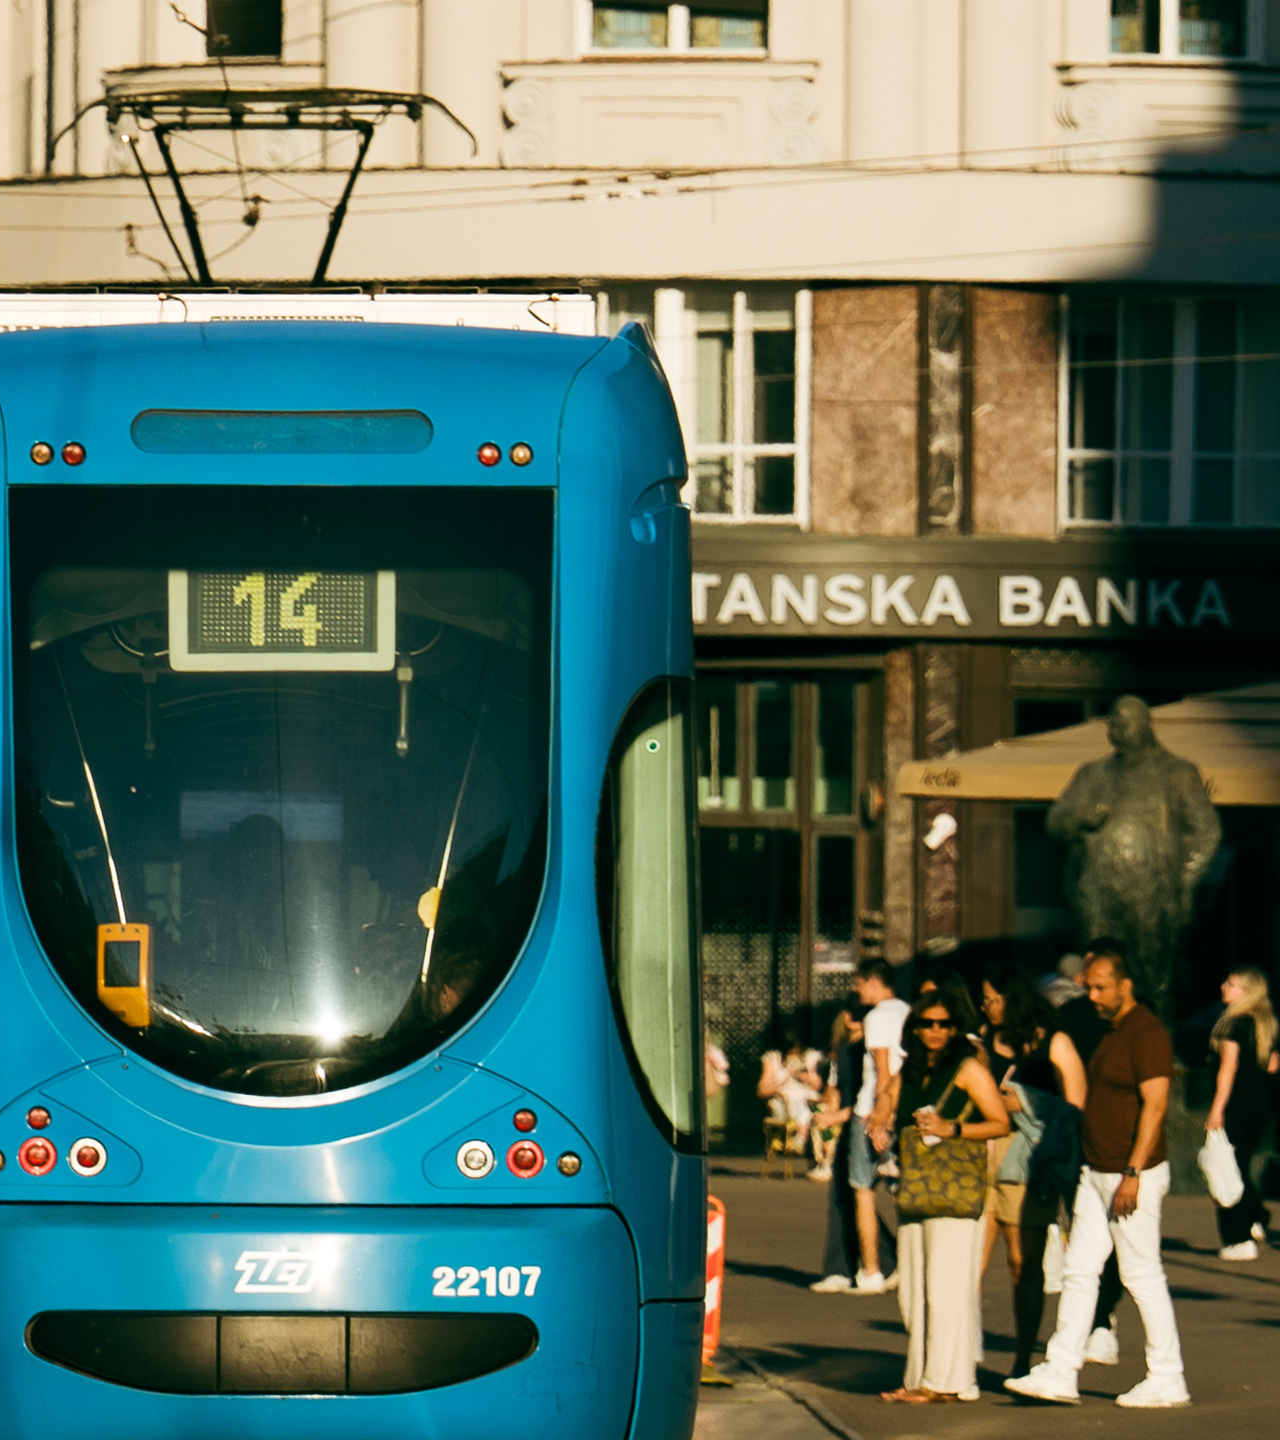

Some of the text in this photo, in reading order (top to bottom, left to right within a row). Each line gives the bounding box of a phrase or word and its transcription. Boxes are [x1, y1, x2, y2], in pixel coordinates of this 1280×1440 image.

[232, 572, 323, 647] 14
[999, 576, 1232, 627] BANKA
[432, 1266, 541, 1297] 22107
